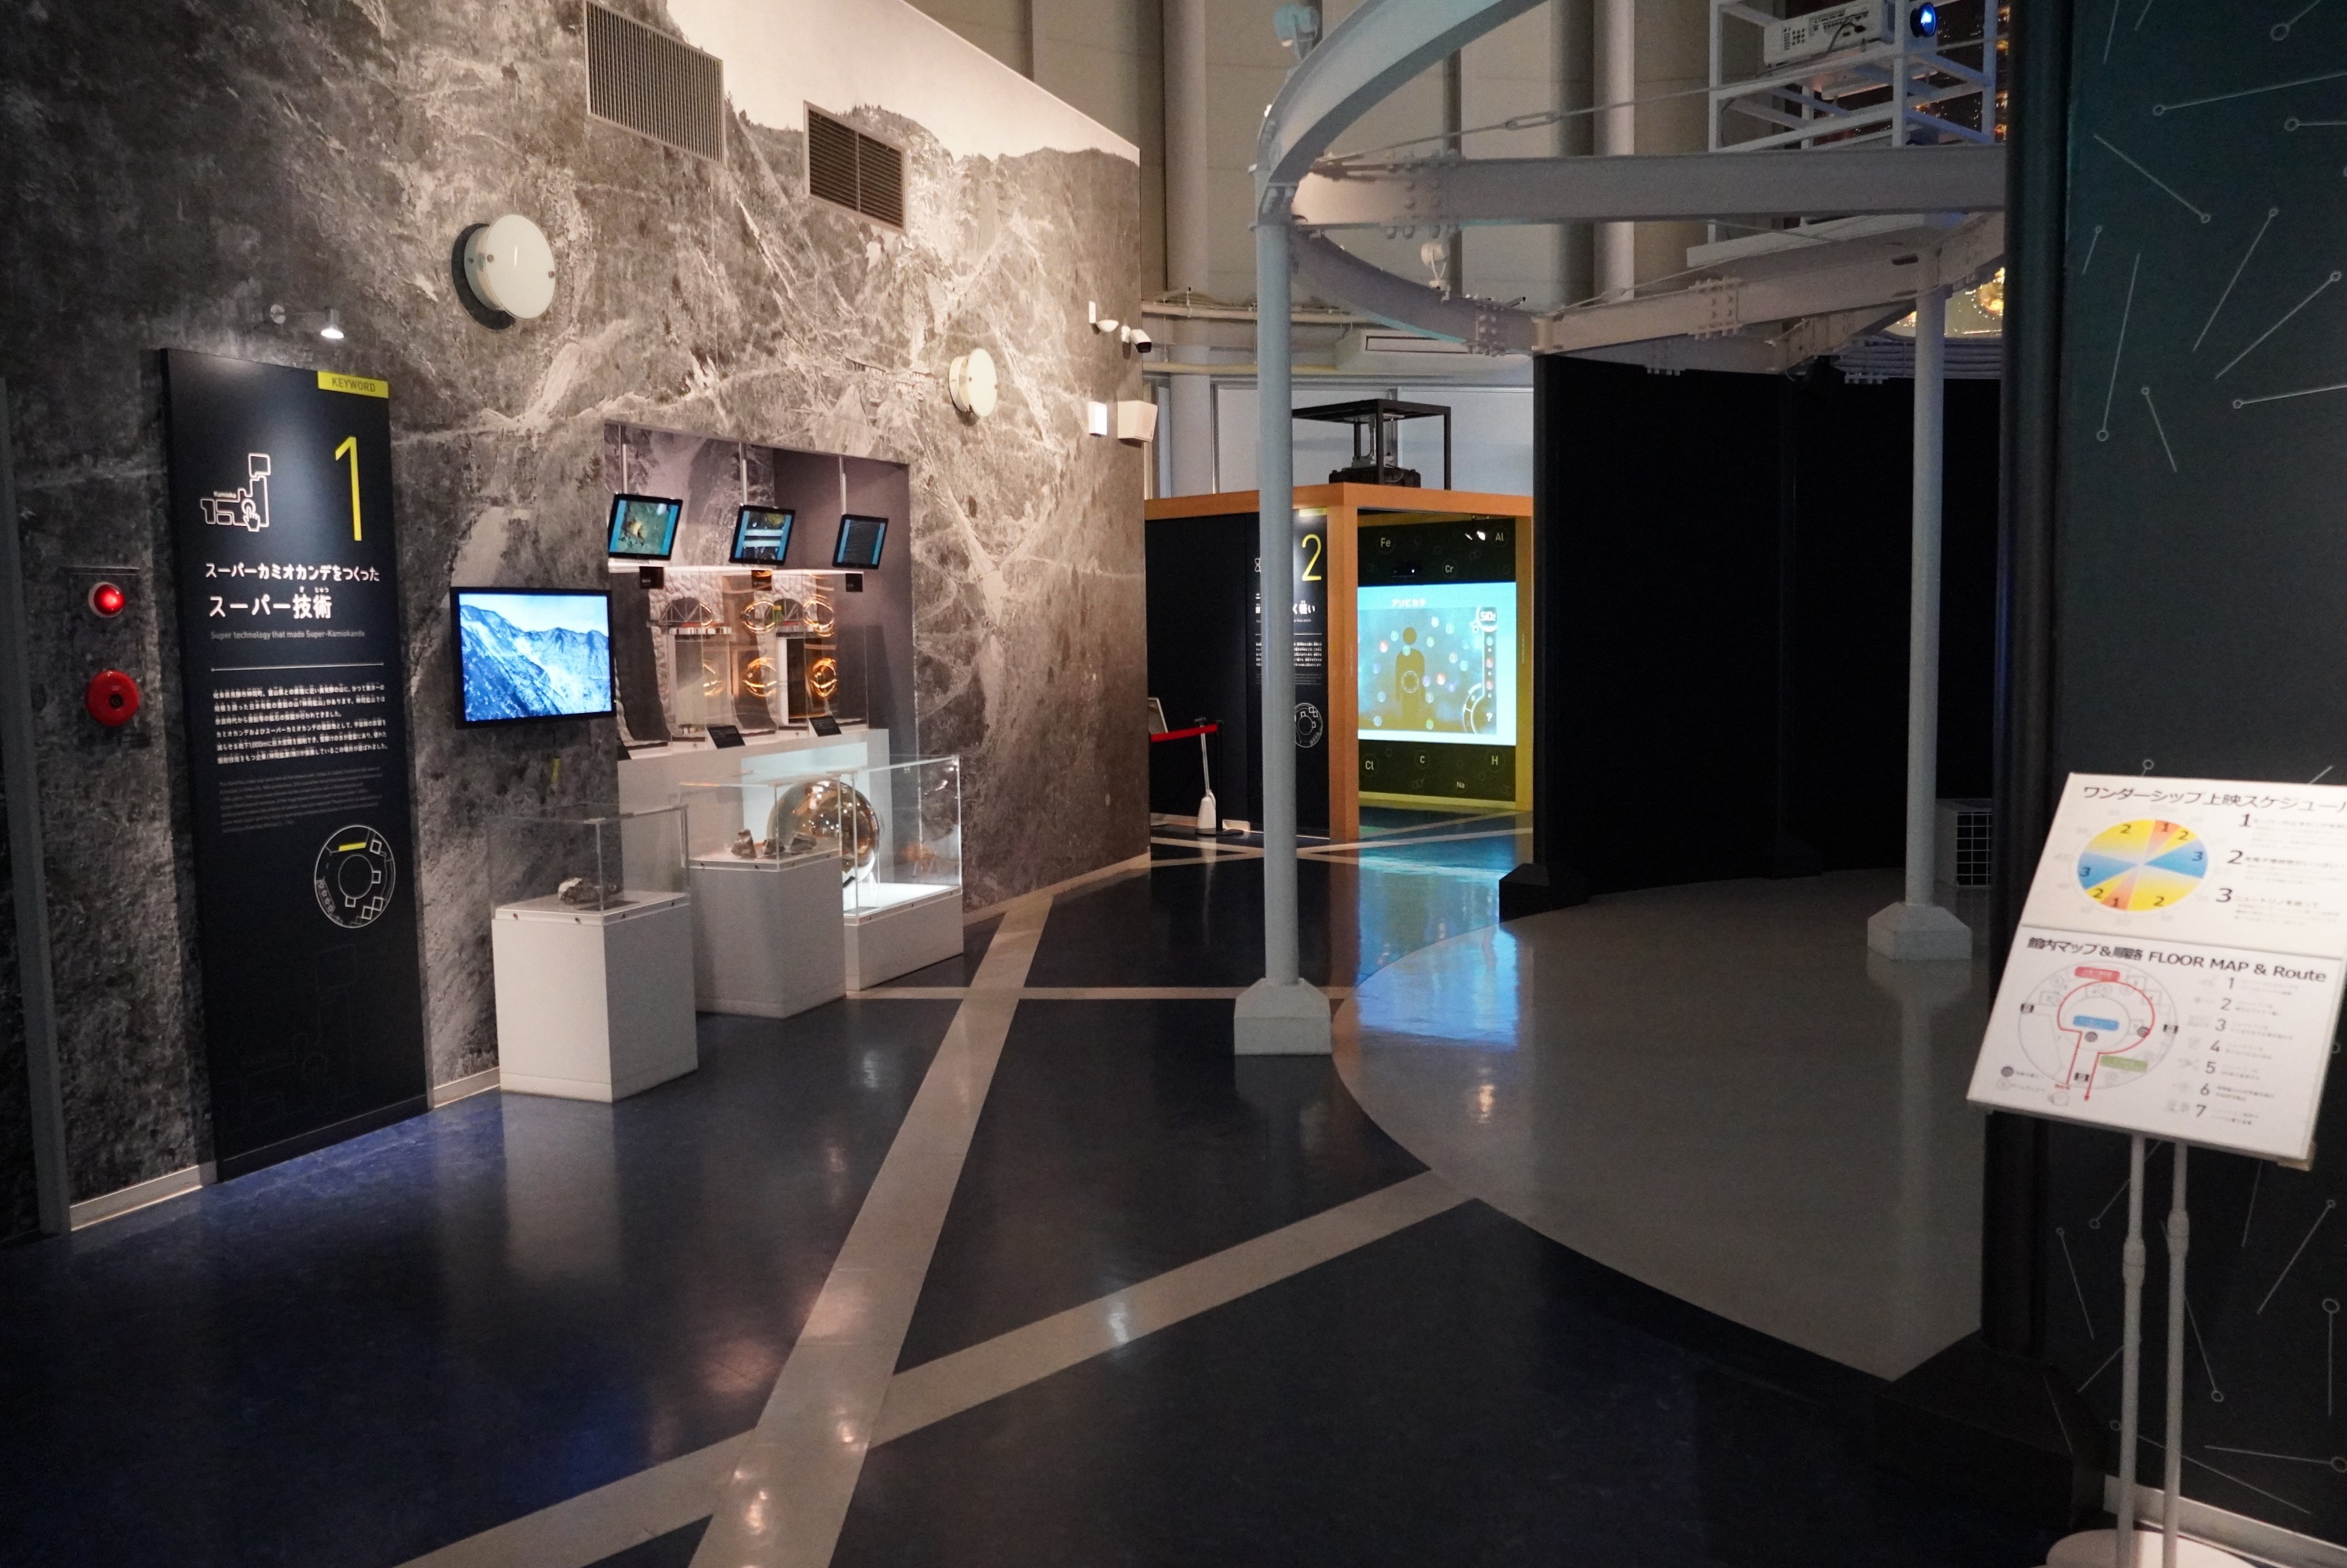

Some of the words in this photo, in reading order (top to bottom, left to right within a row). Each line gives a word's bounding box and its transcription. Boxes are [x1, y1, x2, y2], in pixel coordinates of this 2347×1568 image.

[332, 377, 376, 392] KEYWORD
[335, 436, 362, 541] 1
[1380, 537, 1391, 547] Fe
[1495, 532, 1504, 541] Al
[1302, 534, 1321, 581] 2
[206, 562, 380, 582] スーパーカミオカンデをつくった
[1445, 565, 1454, 573] Cr
[209, 593, 333, 620] スーパー技術
[210, 631, 232, 641] Super
[233, 631, 271, 641] technology
[272, 630, 285, 638] that
[287, 630, 305, 638] made
[306, 629, 366, 639] Super-Kamiokande
[1365, 760, 1374, 770] Cl
[1420, 755, 1425, 764] C
[1491, 755, 1499, 766] H
[2239, 813, 2251, 827] 1
[2120, 824, 2131, 834] 2
[2160, 821, 2170, 833] 1
[2178, 830, 2189, 841] 2
[2191, 851, 2204, 862] 3
[2227, 850, 2243, 865] 2
[2079, 867, 2091, 877] 3
[2093, 888, 2104, 898] 2
[2215, 887, 2233, 903] 3
[2111, 897, 2119, 908] 1
[2153, 896, 2165, 907] 2
[2149, 951, 2204, 967] FLOOR
[2210, 957, 2249, 972] MAP
[2254, 963, 2267, 976] &
[2273, 965, 2327, 982] Route
[2228, 977, 2235, 990] 1
[2220, 998, 2232, 1011] 2
[2215, 1018, 2226, 1032] 3
[2210, 1040, 2220, 1053] 4
[2205, 1061, 2217, 1074] 5
[2200, 1082, 2210, 1096] 6
[2195, 1104, 2207, 1118] 7
